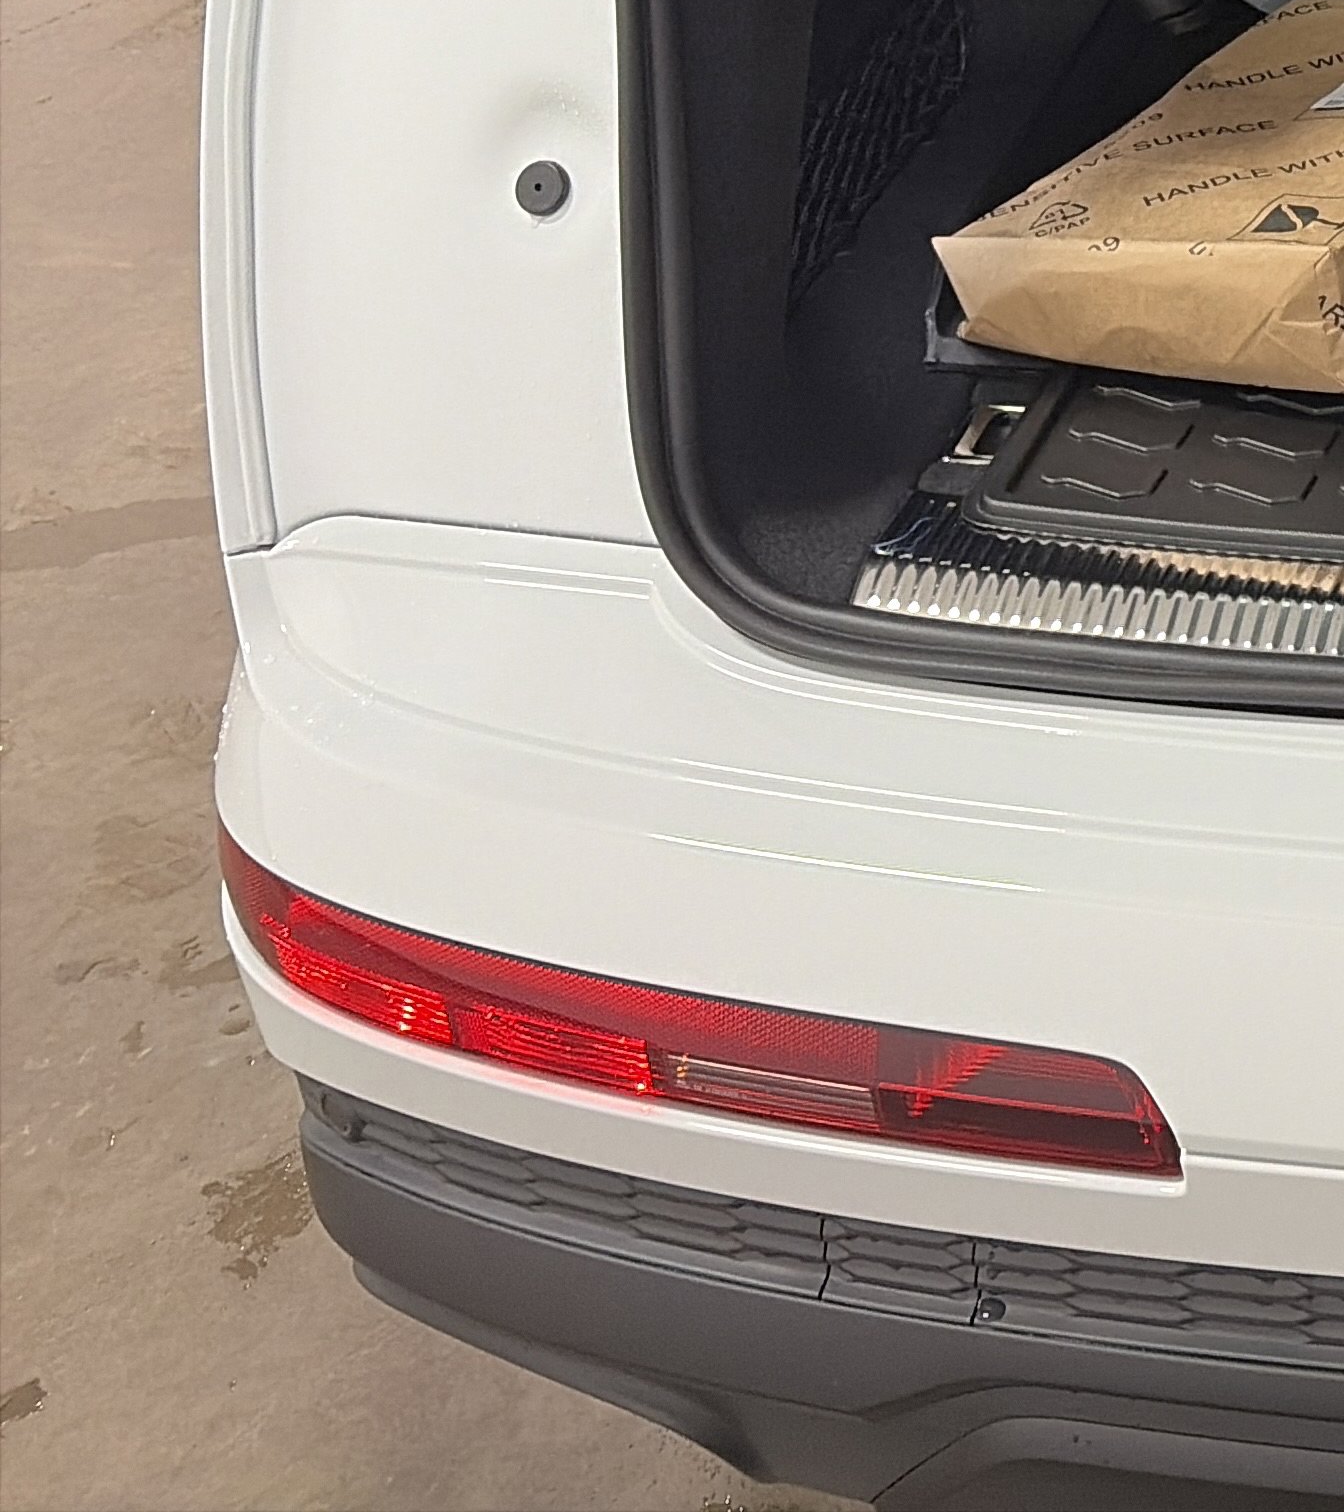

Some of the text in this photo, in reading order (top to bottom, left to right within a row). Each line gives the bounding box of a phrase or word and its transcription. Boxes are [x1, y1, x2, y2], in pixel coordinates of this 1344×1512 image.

[1184, 63, 1304, 92] HANDLE
[1132, 120, 1279, 152] SURFACE
[1142, 166, 1273, 207] HANDLE
[1034, 217, 1091, 238] C/PAP
